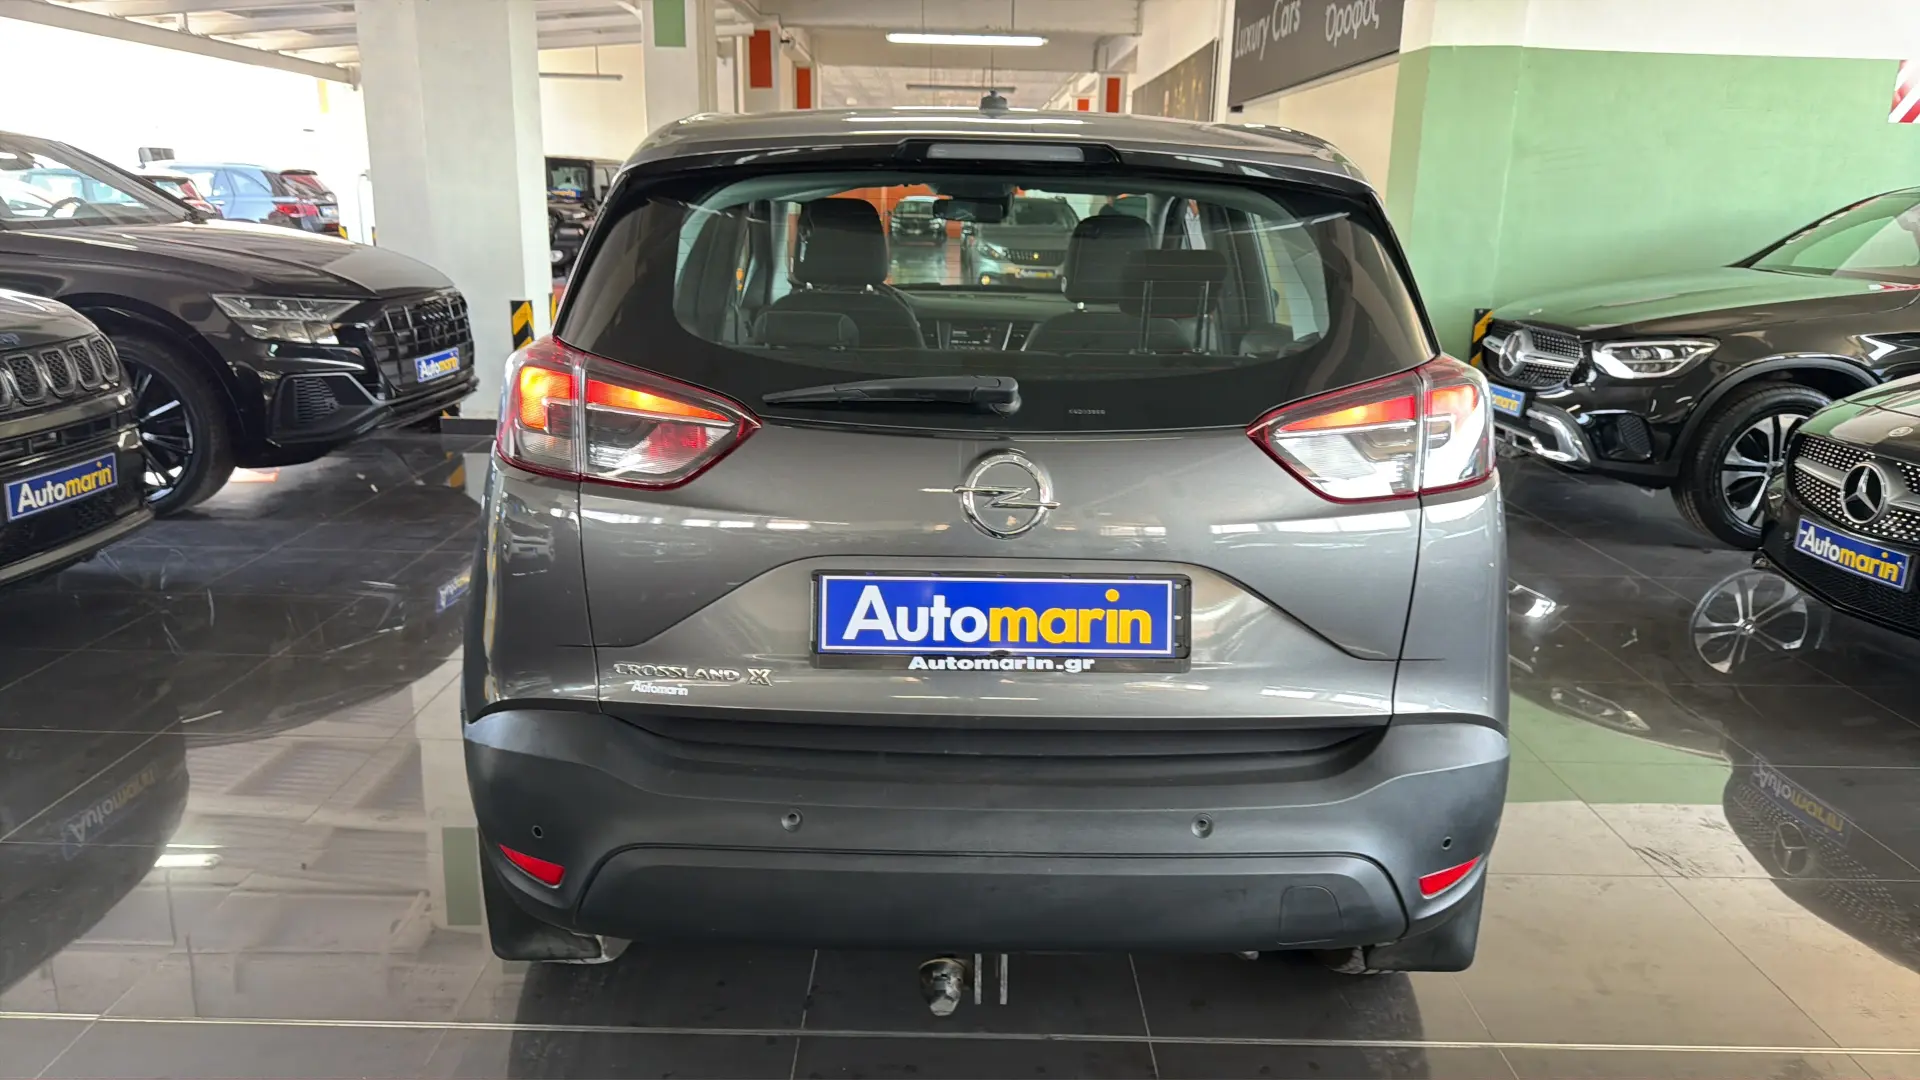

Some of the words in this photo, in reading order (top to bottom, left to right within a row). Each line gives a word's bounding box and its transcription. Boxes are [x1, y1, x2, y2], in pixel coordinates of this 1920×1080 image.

[1234, 14, 1270, 61] Luxury
[1272, 0, 1301, 42] Cars
[17, 461, 113, 512] Automarin
[1801, 525, 1900, 582] Automarin
[842, 585, 1152, 644] Automarin
[613, 662, 741, 682] CROSSLAND
[748, 668, 773, 687] X
[631, 679, 688, 696] Automarin
[908, 656, 1095, 673] Automarin.gr
